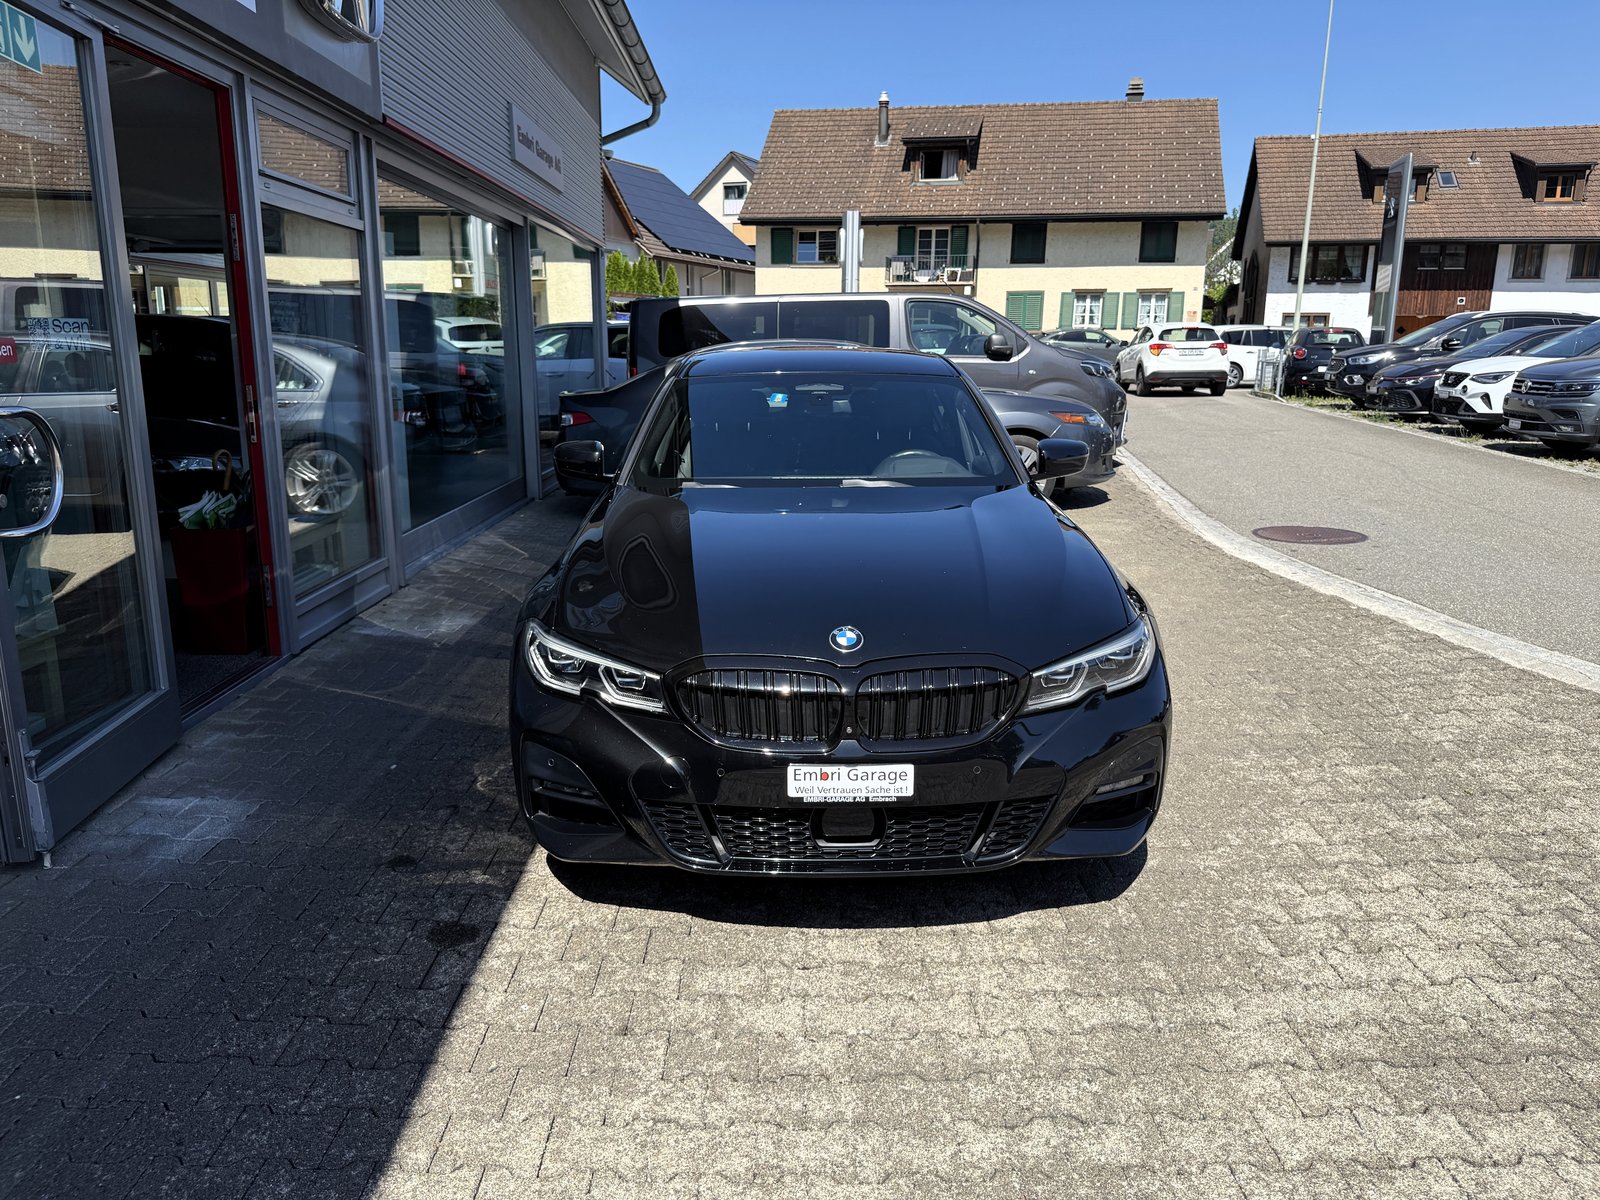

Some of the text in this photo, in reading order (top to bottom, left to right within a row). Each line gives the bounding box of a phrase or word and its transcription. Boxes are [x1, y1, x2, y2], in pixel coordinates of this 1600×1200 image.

[516, 124, 535, 154] Embri
[535, 140, 554, 169] Garage
[0, 345, 14, 356] en
[793, 768, 908, 785] Embri Garage
[794, 786, 814, 794] Weil
[817, 786, 863, 794] Vertrauen
[865, 786, 891, 794] Sache
